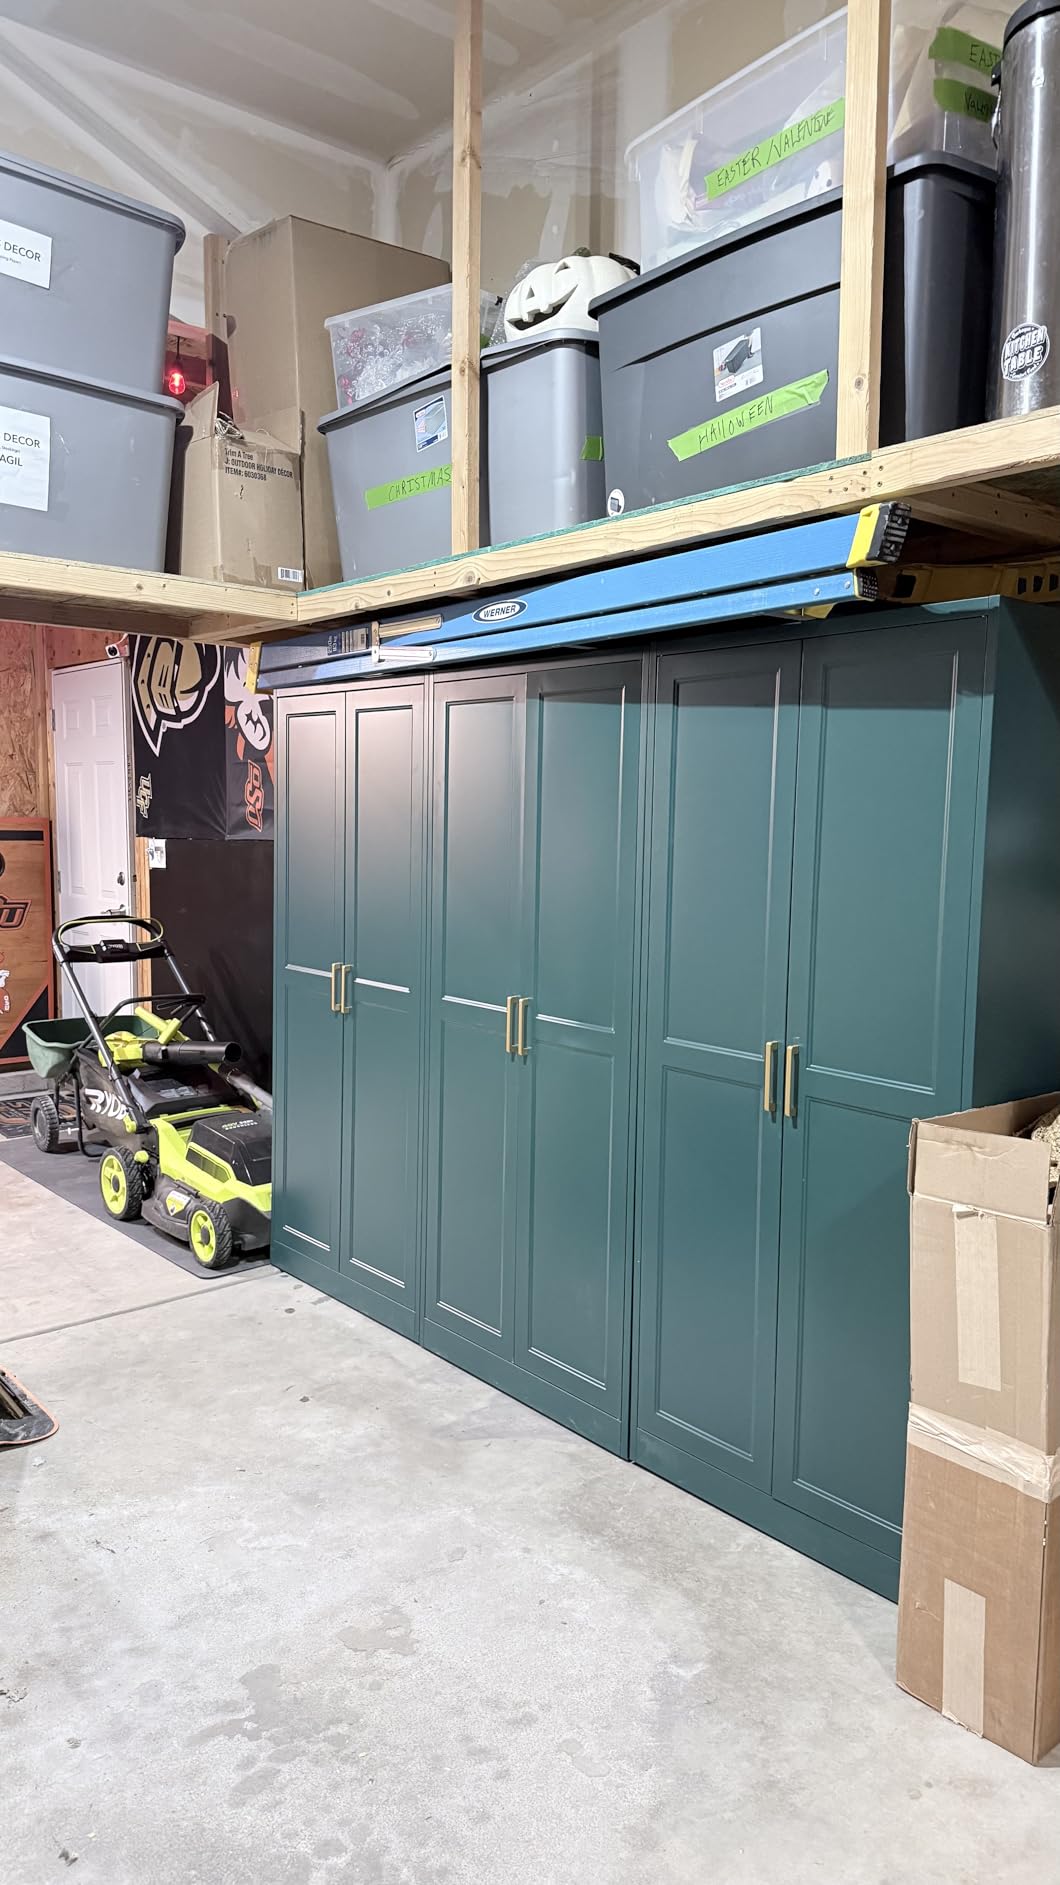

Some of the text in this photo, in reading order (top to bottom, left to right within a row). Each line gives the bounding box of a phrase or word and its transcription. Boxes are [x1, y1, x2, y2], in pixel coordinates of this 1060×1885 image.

[717, 146, 762, 187] EASTER
[4, 241, 41, 262] DECOR
[1004, 329, 1046, 360] KITCHEN
[1003, 345, 1044, 378] TABLE
[3, 432, 41, 448] DECOR
[224, 447, 254, 461] Trim A Tree
[231, 458, 256, 470] OUTDOOR
[256, 463, 277, 475] HOLIDAY
[388, 467, 452, 501] CHRISTMAS
[483, 604, 517, 618] WERNER
